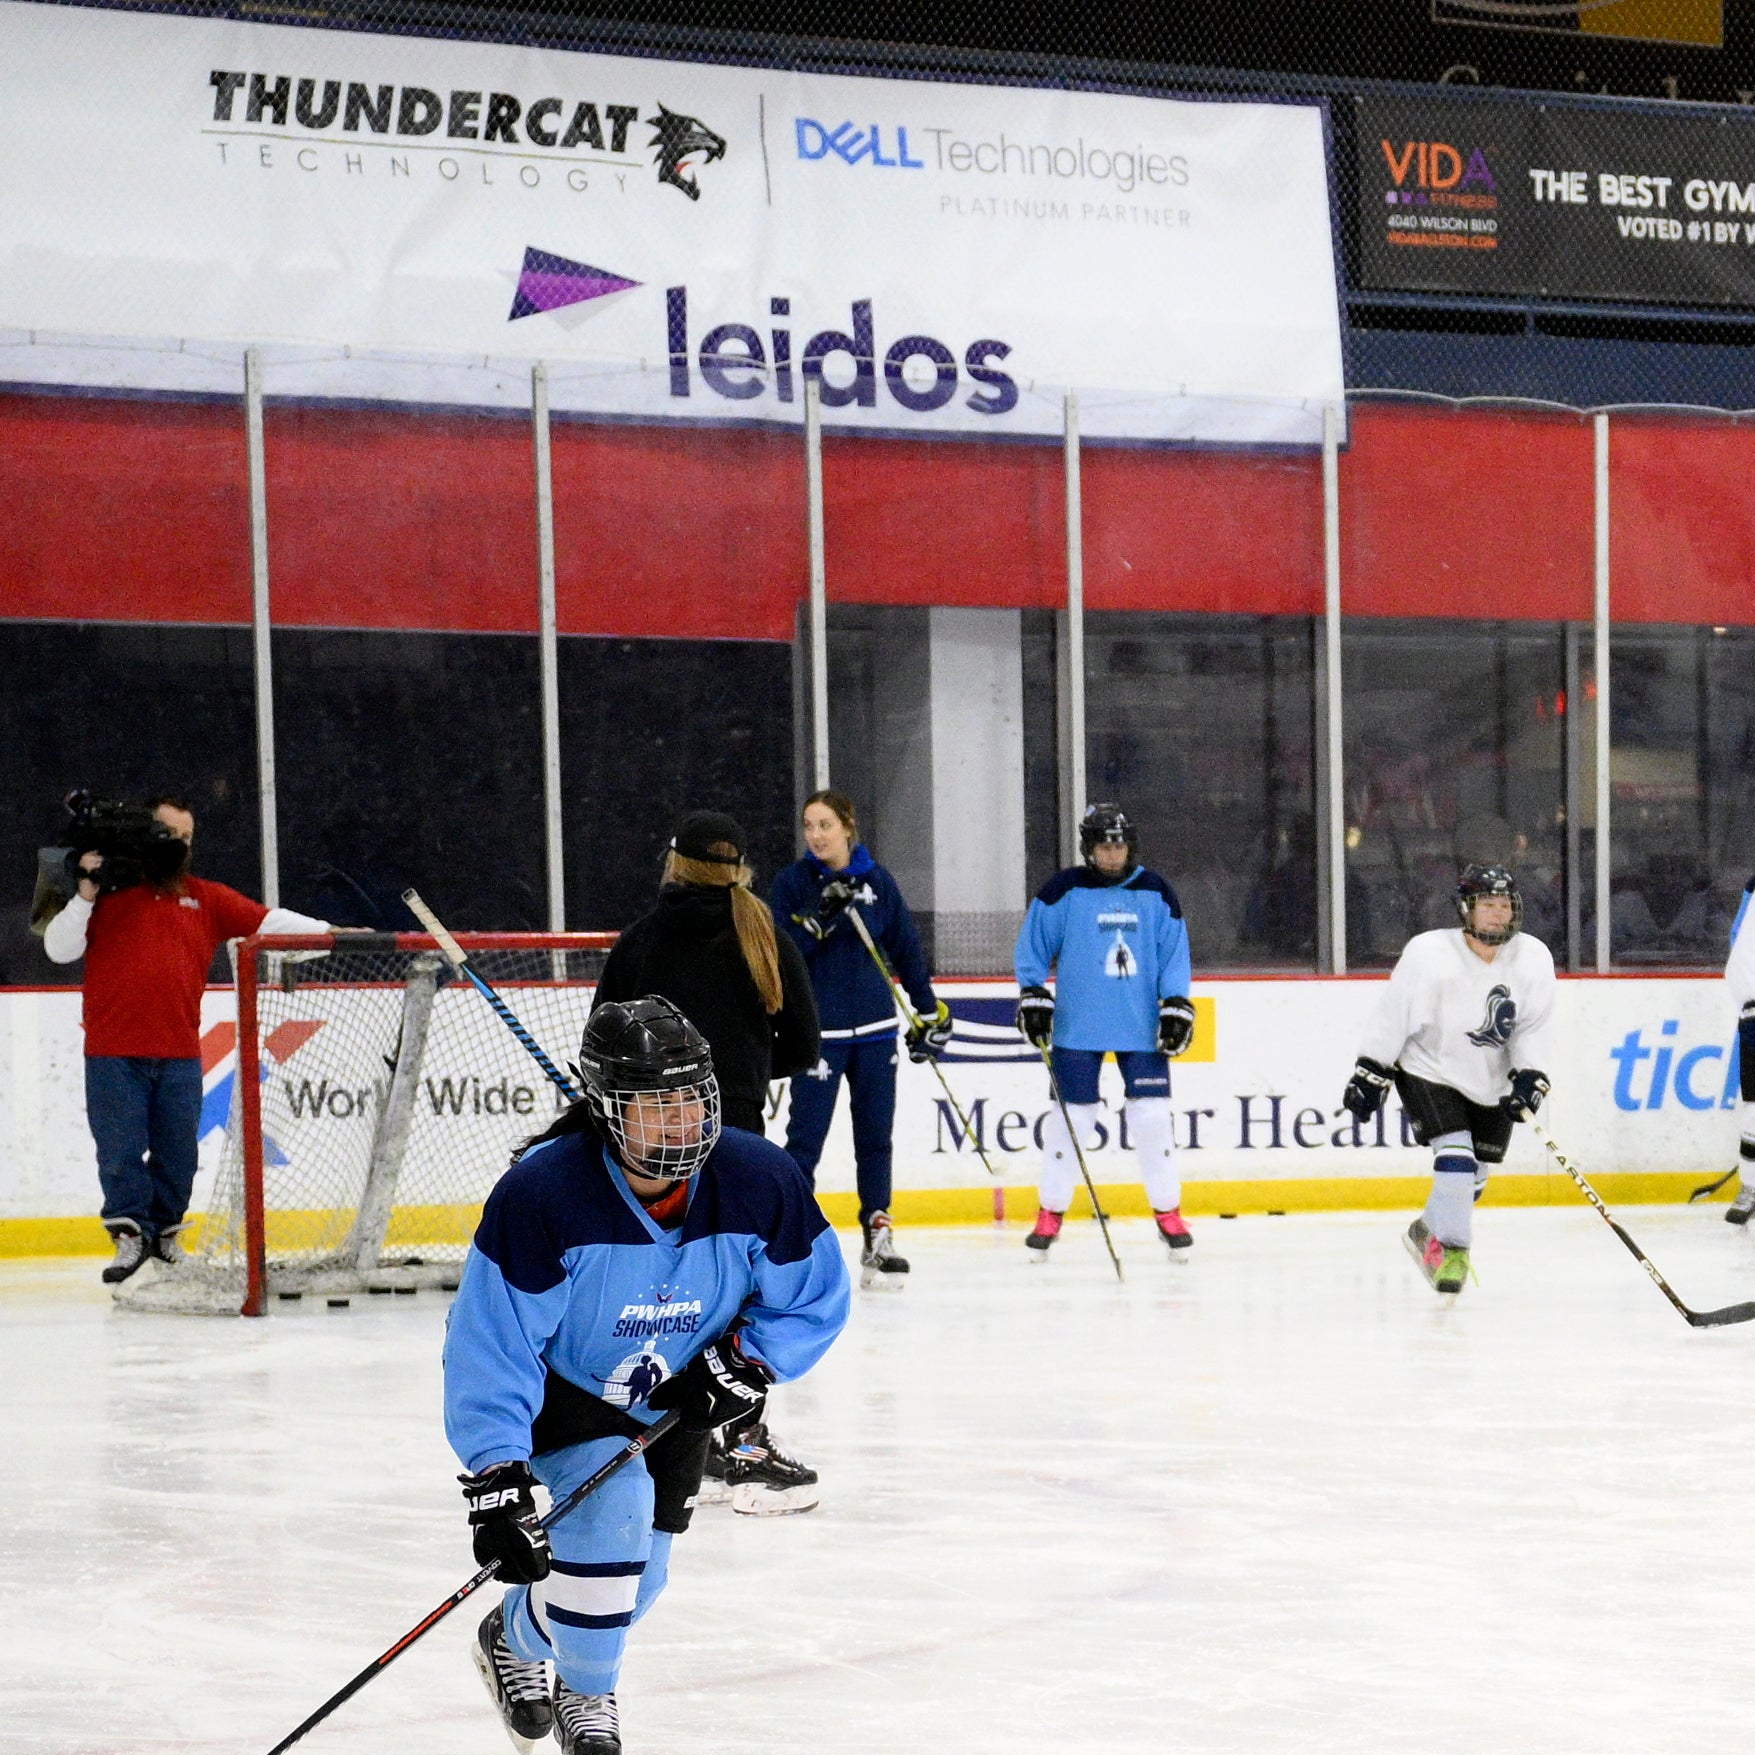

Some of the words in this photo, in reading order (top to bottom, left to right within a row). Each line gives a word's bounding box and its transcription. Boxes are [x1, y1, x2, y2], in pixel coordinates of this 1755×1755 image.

[208, 69, 640, 154] THUNDERCAT
[214, 141, 629, 194] TECHNOLOGY
[795, 118, 925, 170] DELL
[922, 127, 1190, 193] Technologies
[1381, 139, 1497, 190] VIDA
[1529, 168, 1588, 204] THE
[1599, 173, 1672, 209] BEST
[940, 195, 1070, 222] PLATINUM
[1082, 202, 1191, 229] PARTNER
[1419, 216, 1469, 231] WILSON
[1470, 219, 1499, 233] BLVD
[1616, 214, 1683, 241] VOTED
[1714, 221, 1740, 244] BY
[666, 284, 1020, 416] leidos
[662, 1062, 699, 1076] BAUER
[423, 1076, 536, 1117] Wide
[611, 1313, 701, 1338] SHOWCASE
[619, 1299, 702, 1321] PWHPA
[703, 1345, 765, 1404] BAUER
